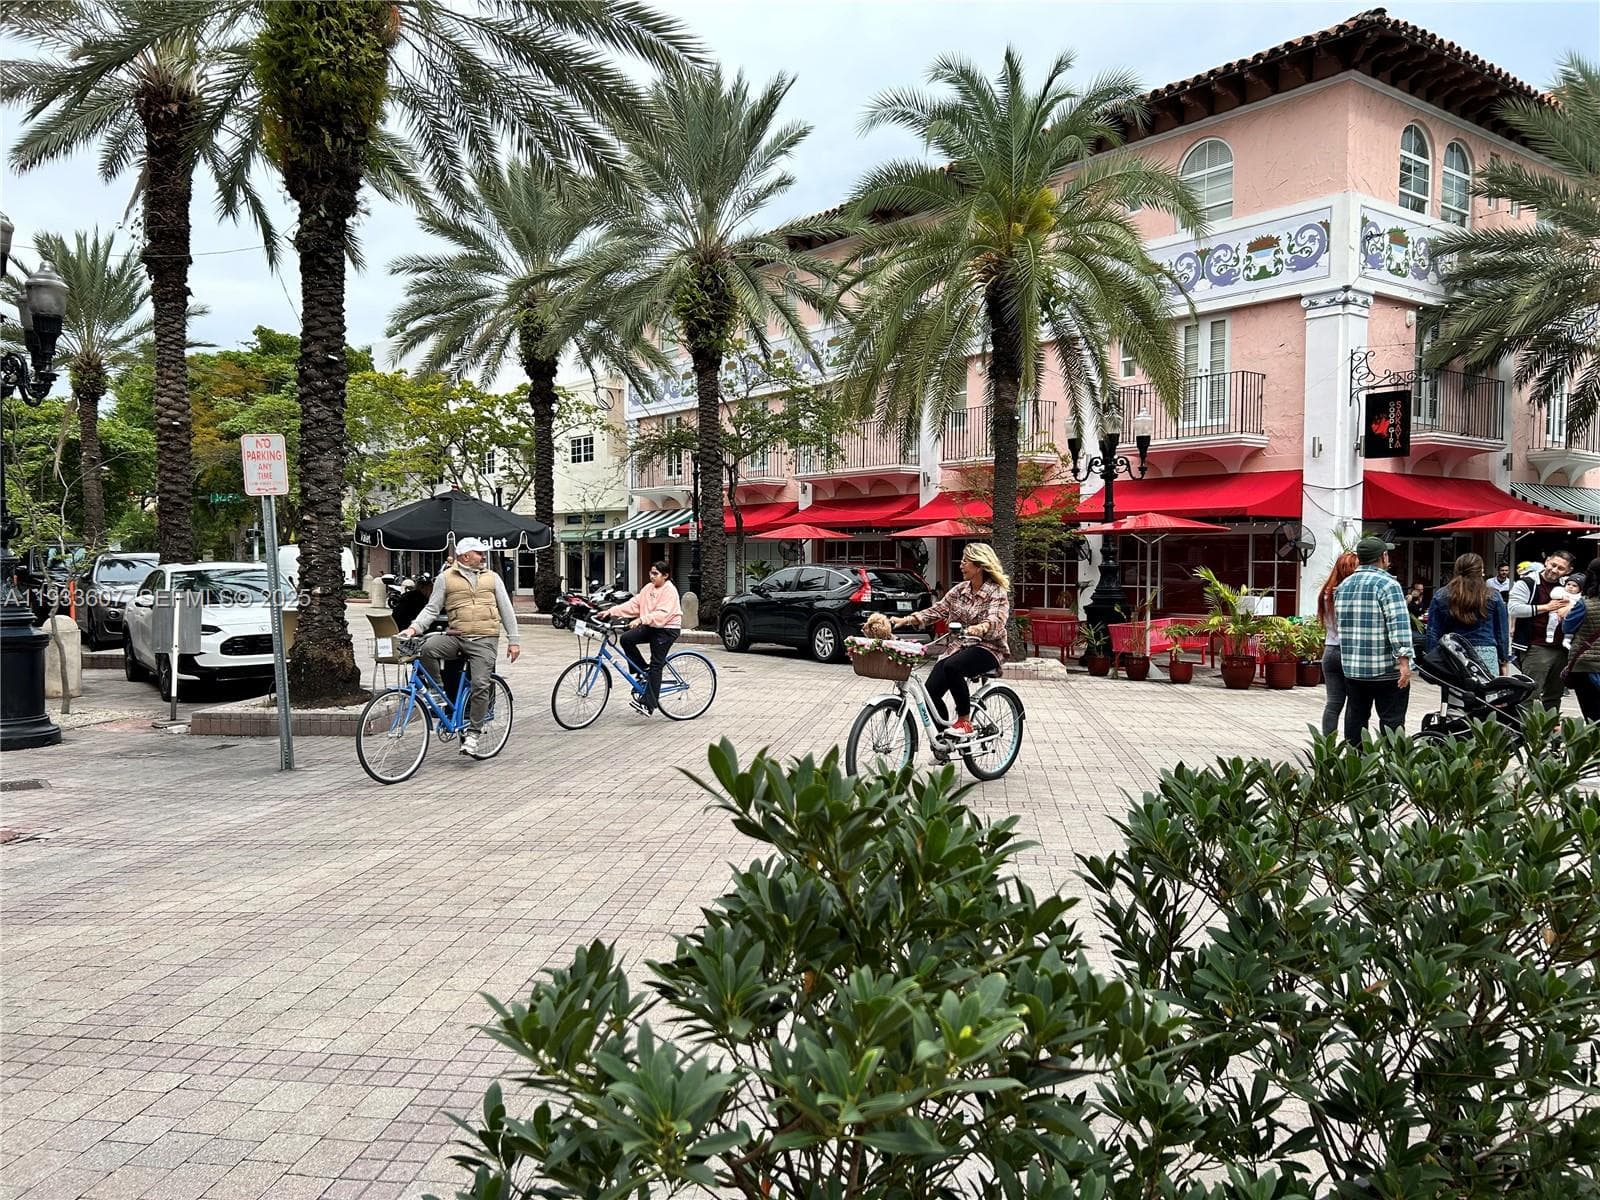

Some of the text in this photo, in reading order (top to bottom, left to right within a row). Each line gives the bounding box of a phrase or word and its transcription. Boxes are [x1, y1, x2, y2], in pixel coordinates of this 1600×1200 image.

[255, 438, 271, 449] NO
[246, 450, 282, 461] PARKING
[257, 472, 273, 480] TIME
[478, 536, 507, 548] alet
